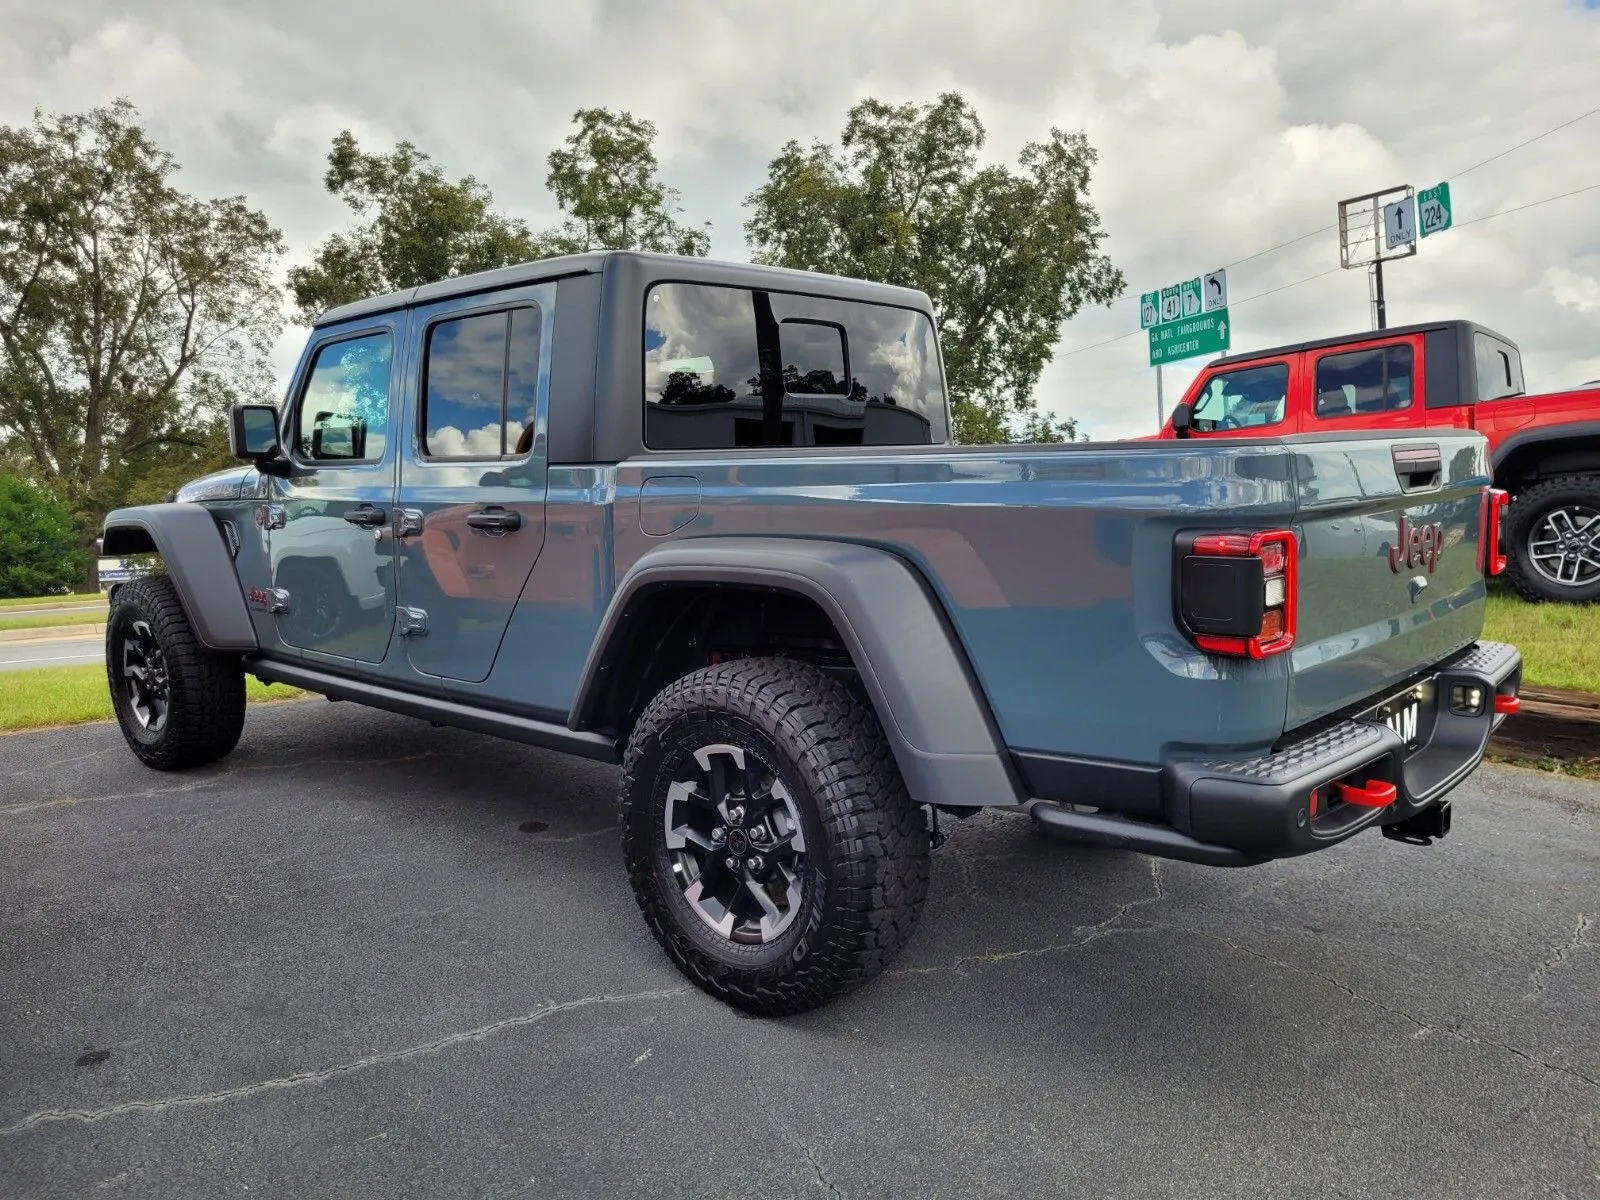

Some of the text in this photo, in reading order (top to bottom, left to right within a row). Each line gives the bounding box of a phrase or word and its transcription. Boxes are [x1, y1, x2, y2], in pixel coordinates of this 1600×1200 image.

[1423, 188, 1442, 201] EAST
[1424, 204, 1442, 229] 224
[1390, 229, 1411, 244] ONLY
[1162, 287, 1179, 298] NORTH
[1182, 280, 1200, 290] NORTH
[1145, 293, 1154, 302] EAST
[1187, 294, 1192, 311] 7
[1209, 298, 1223, 307] ONLY
[1144, 306, 1153, 323] 127
[1166, 300, 1176, 316] 41
[1151, 332, 1159, 343] GA
[1177, 318, 1214, 336] FAIRGROUNDS
[1152, 340, 1200, 360] AND AGRICENTER
[1388, 514, 1443, 573] Jeep
